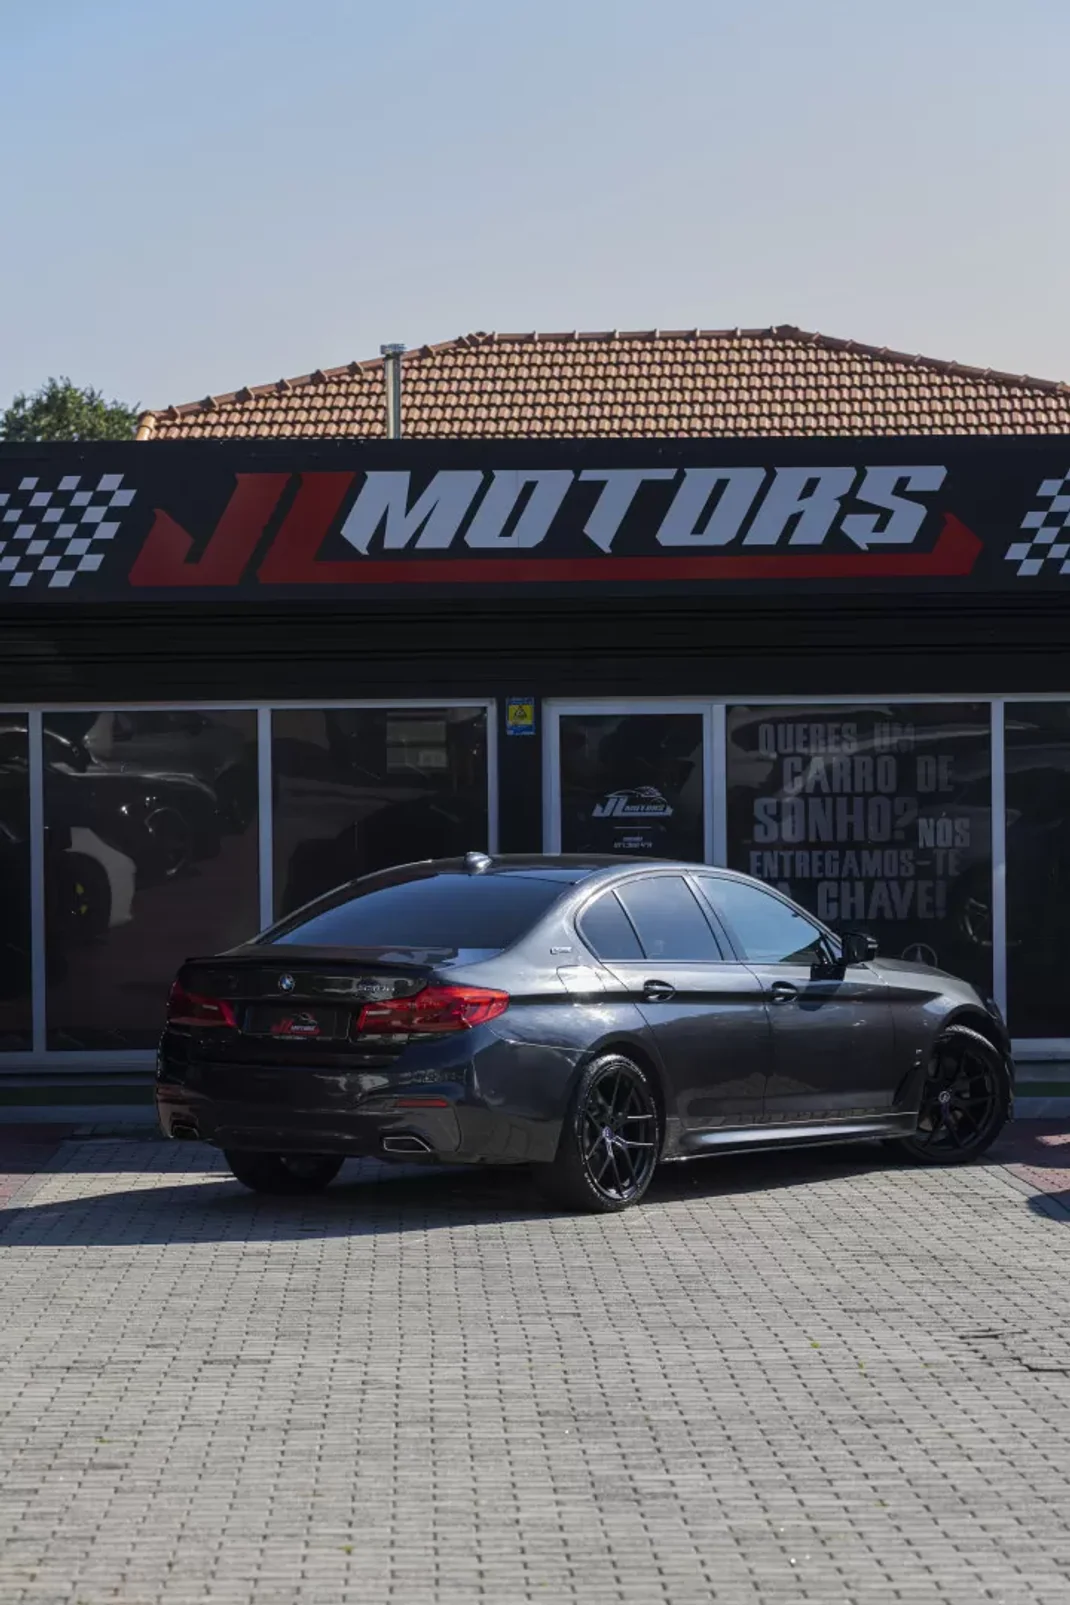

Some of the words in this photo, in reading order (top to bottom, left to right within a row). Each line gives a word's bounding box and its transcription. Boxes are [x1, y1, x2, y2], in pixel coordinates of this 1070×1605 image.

[128, 471, 356, 587] JL
[340, 465, 948, 555] MOTORS
[758, 722, 857, 757] QUERES
[783, 755, 897, 793] CARRO
[916, 755, 954, 792] DE
[753, 795, 918, 843] SONHO?
[918, 812, 970, 848] NÓS
[750, 849, 961, 878] ENTREGAMOS-TE
[817, 880, 947, 921] CHAVE!
